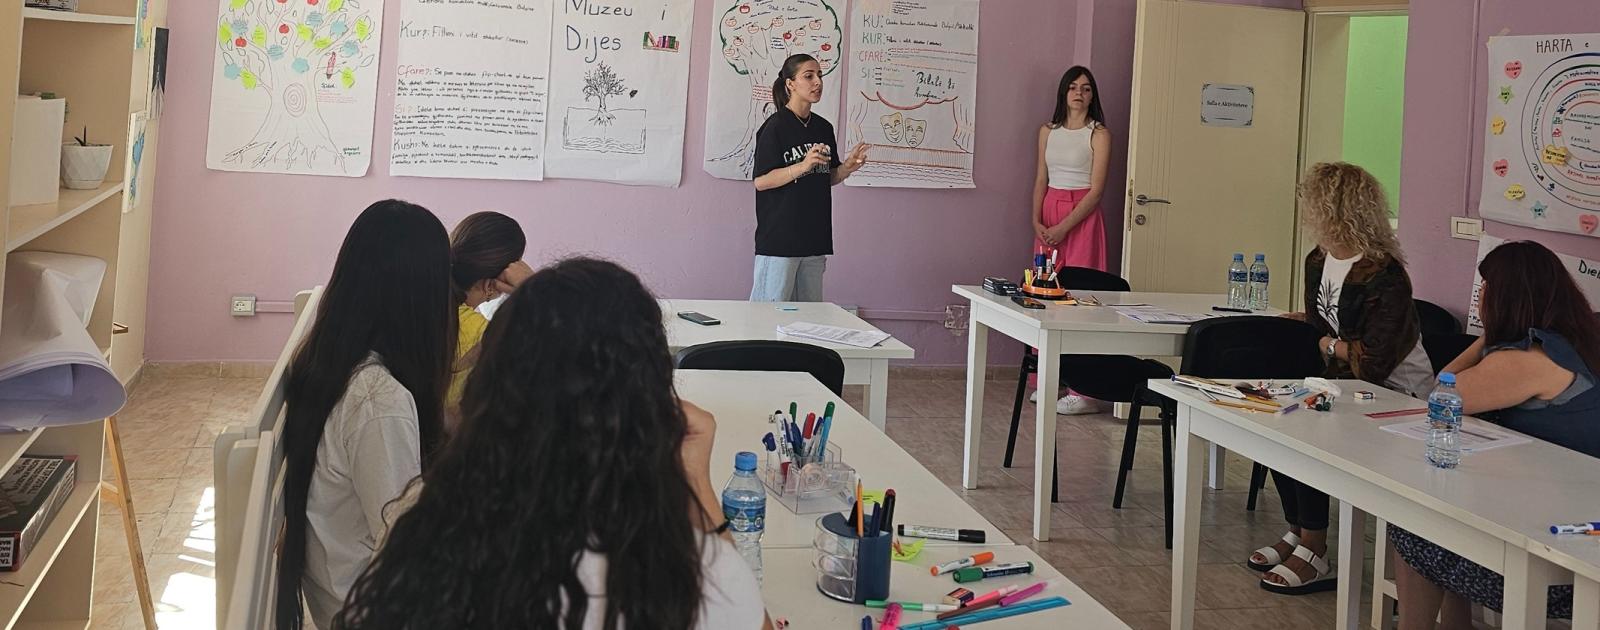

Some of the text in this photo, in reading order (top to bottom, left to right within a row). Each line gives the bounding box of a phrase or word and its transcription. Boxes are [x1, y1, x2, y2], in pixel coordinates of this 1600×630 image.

[564, 0, 668, 21] Muzeu i
[566, 25, 622, 64] Dijes
[1536, 38, 1574, 54] HARTA
